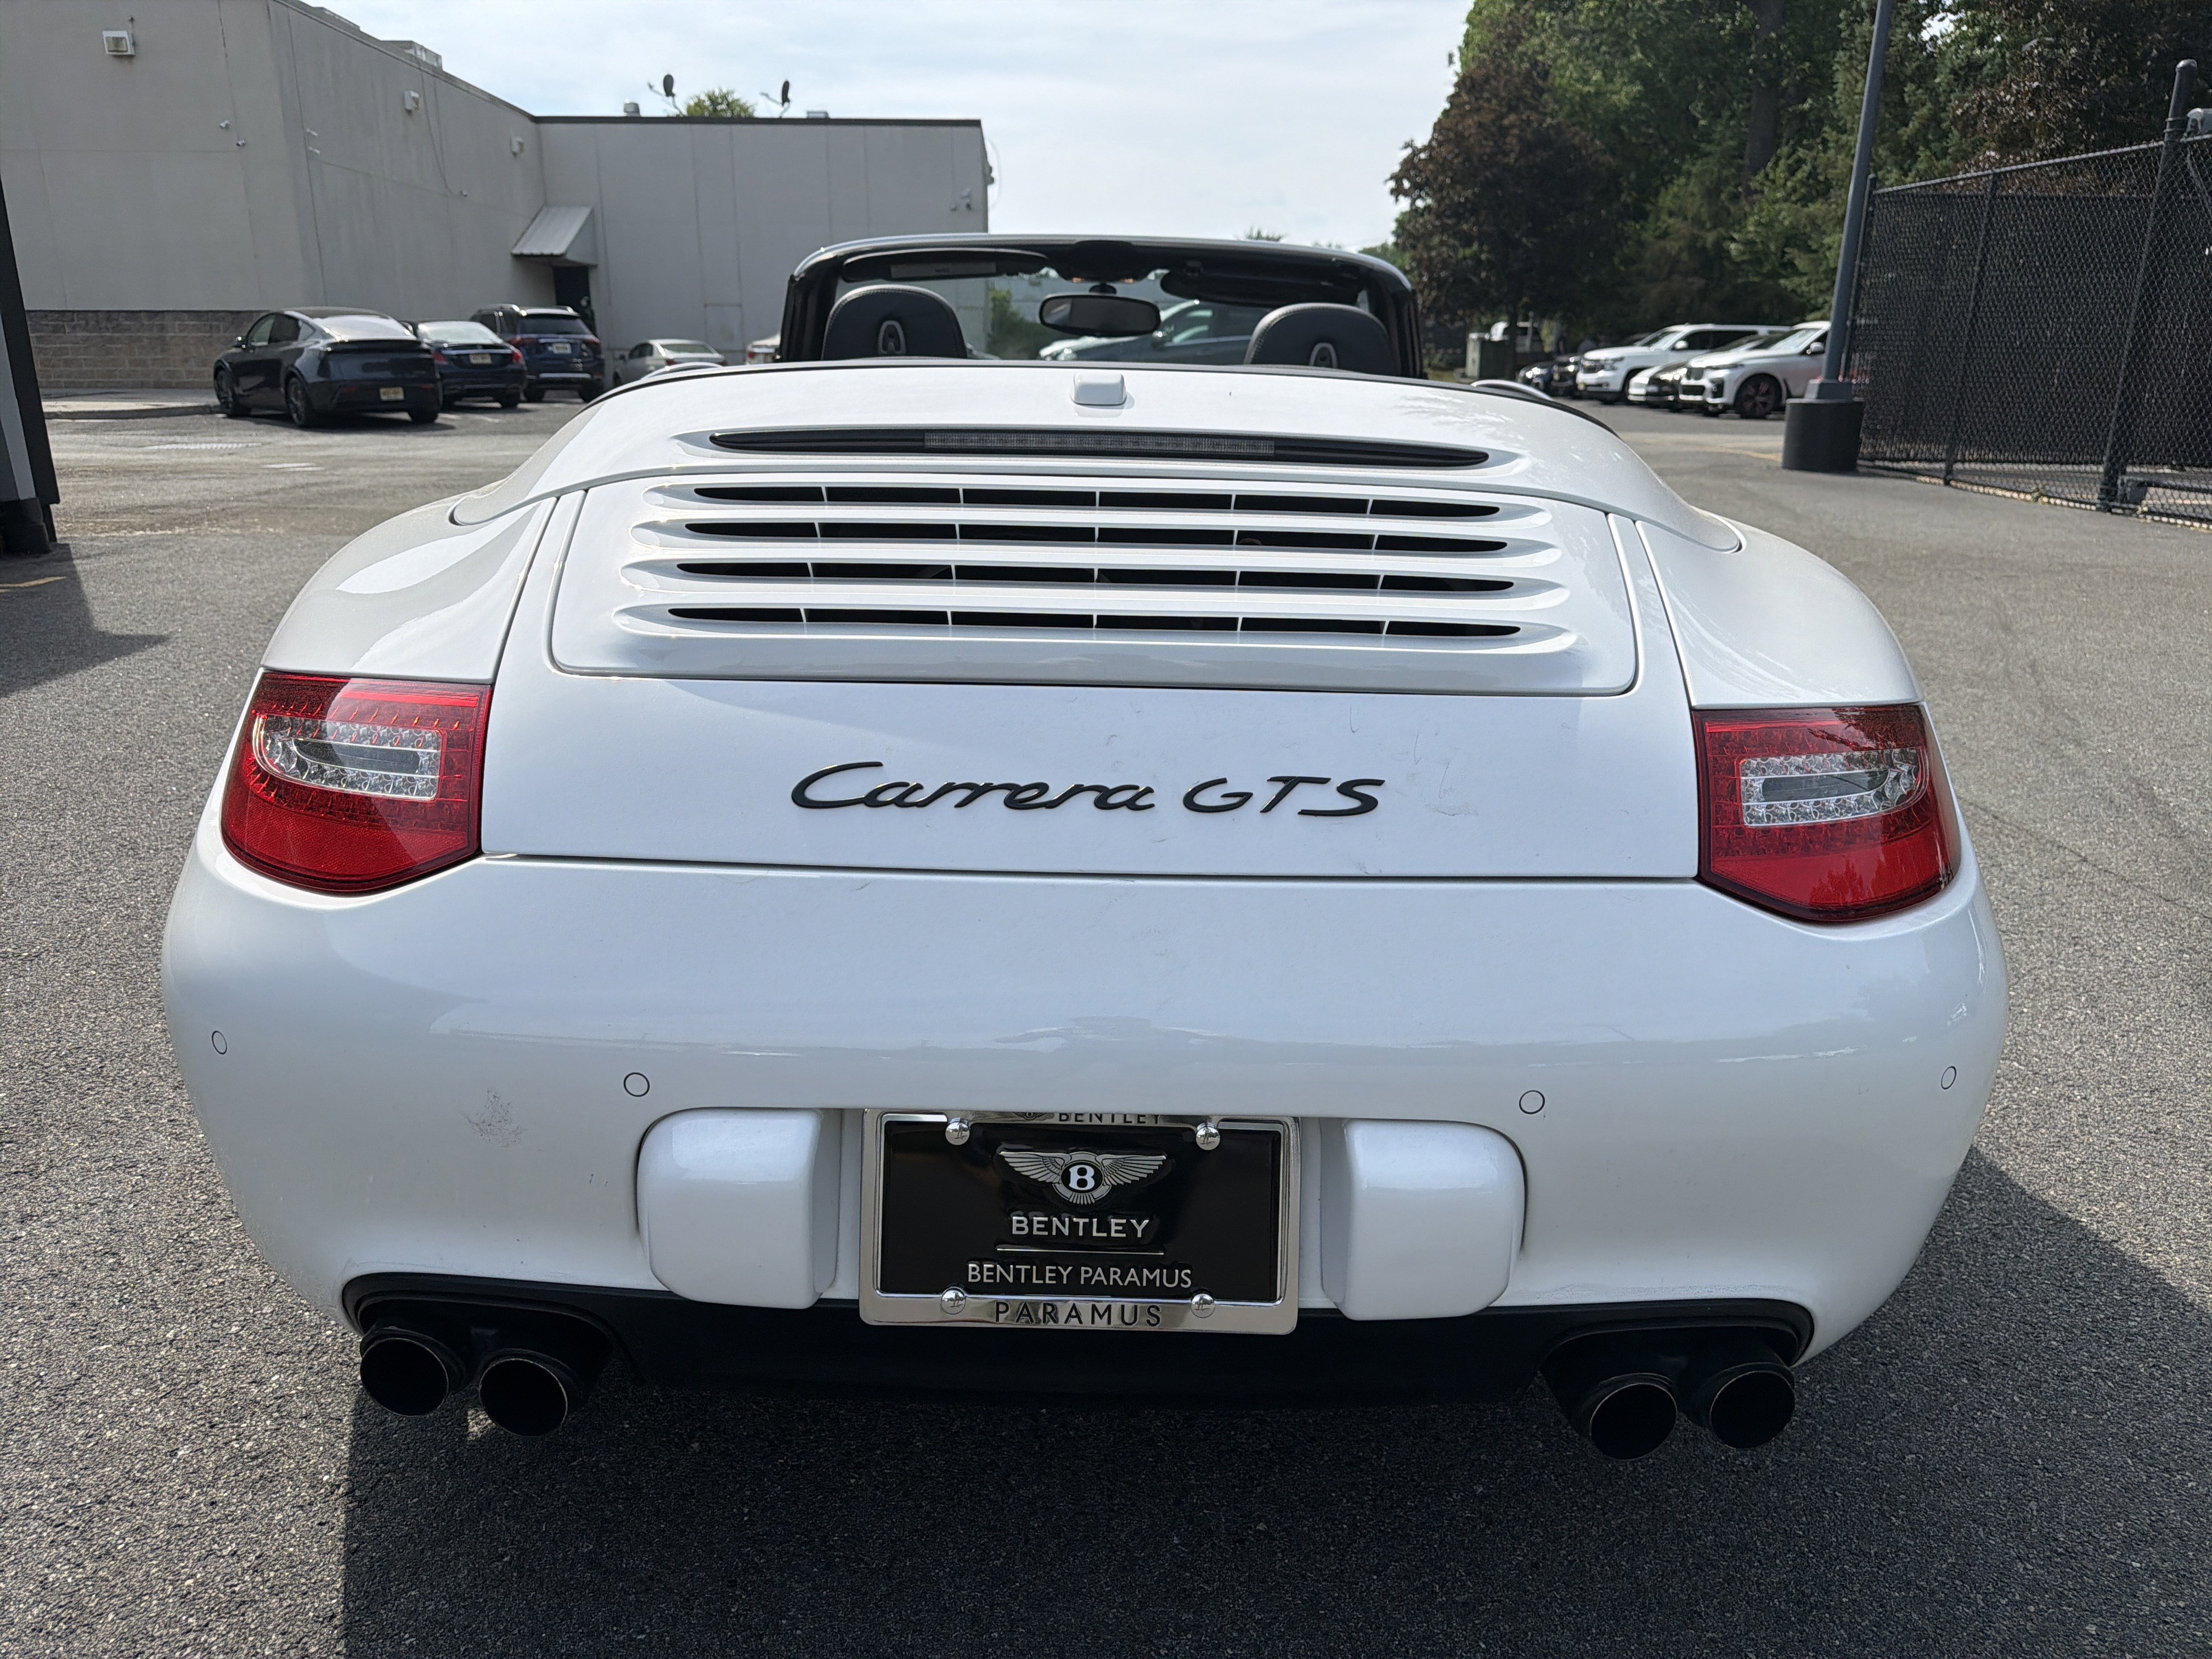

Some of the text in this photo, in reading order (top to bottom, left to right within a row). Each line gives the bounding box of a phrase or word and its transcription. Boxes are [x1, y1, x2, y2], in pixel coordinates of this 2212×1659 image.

[792, 761, 1386, 817] Carrera GTS
[1058, 1112, 1160, 1125] BENTLEY
[1069, 1164, 1095, 1190] B
[1012, 1216, 1149, 1238] BENTLEY
[967, 1263, 1192, 1288] BENTLEY PARAMUS
[995, 1301, 1160, 1327] PARAMUS
